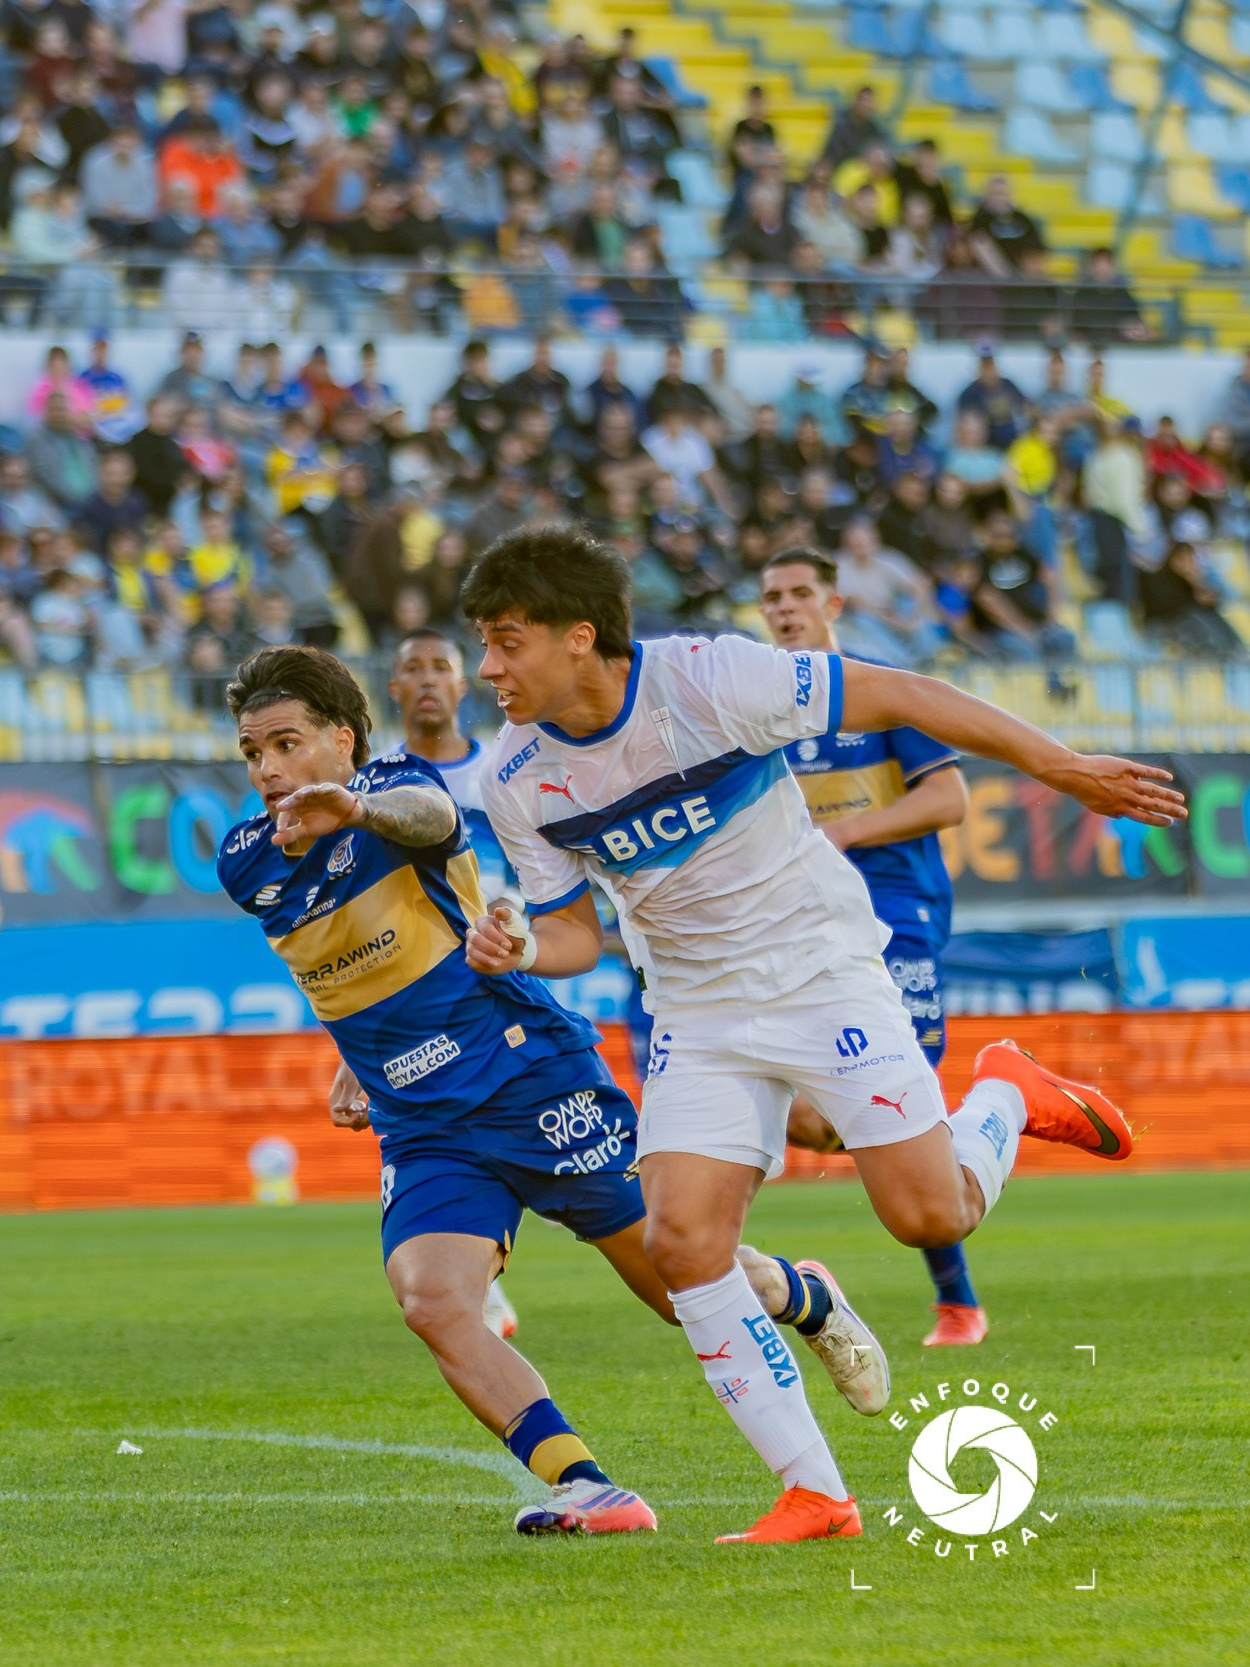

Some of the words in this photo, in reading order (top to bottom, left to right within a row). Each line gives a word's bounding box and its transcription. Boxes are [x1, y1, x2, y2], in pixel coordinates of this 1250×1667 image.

[497, 736, 541, 785] 1XBET
[600, 795, 717, 862] BICE
[333, 944, 402, 986] PROTECTION
[386, 1037, 447, 1075] APUESTAS
[389, 1043, 458, 1087] ROYAL.COM
[554, 1132, 623, 1176] Claro
[741, 1313, 800, 1389] 1XBET
